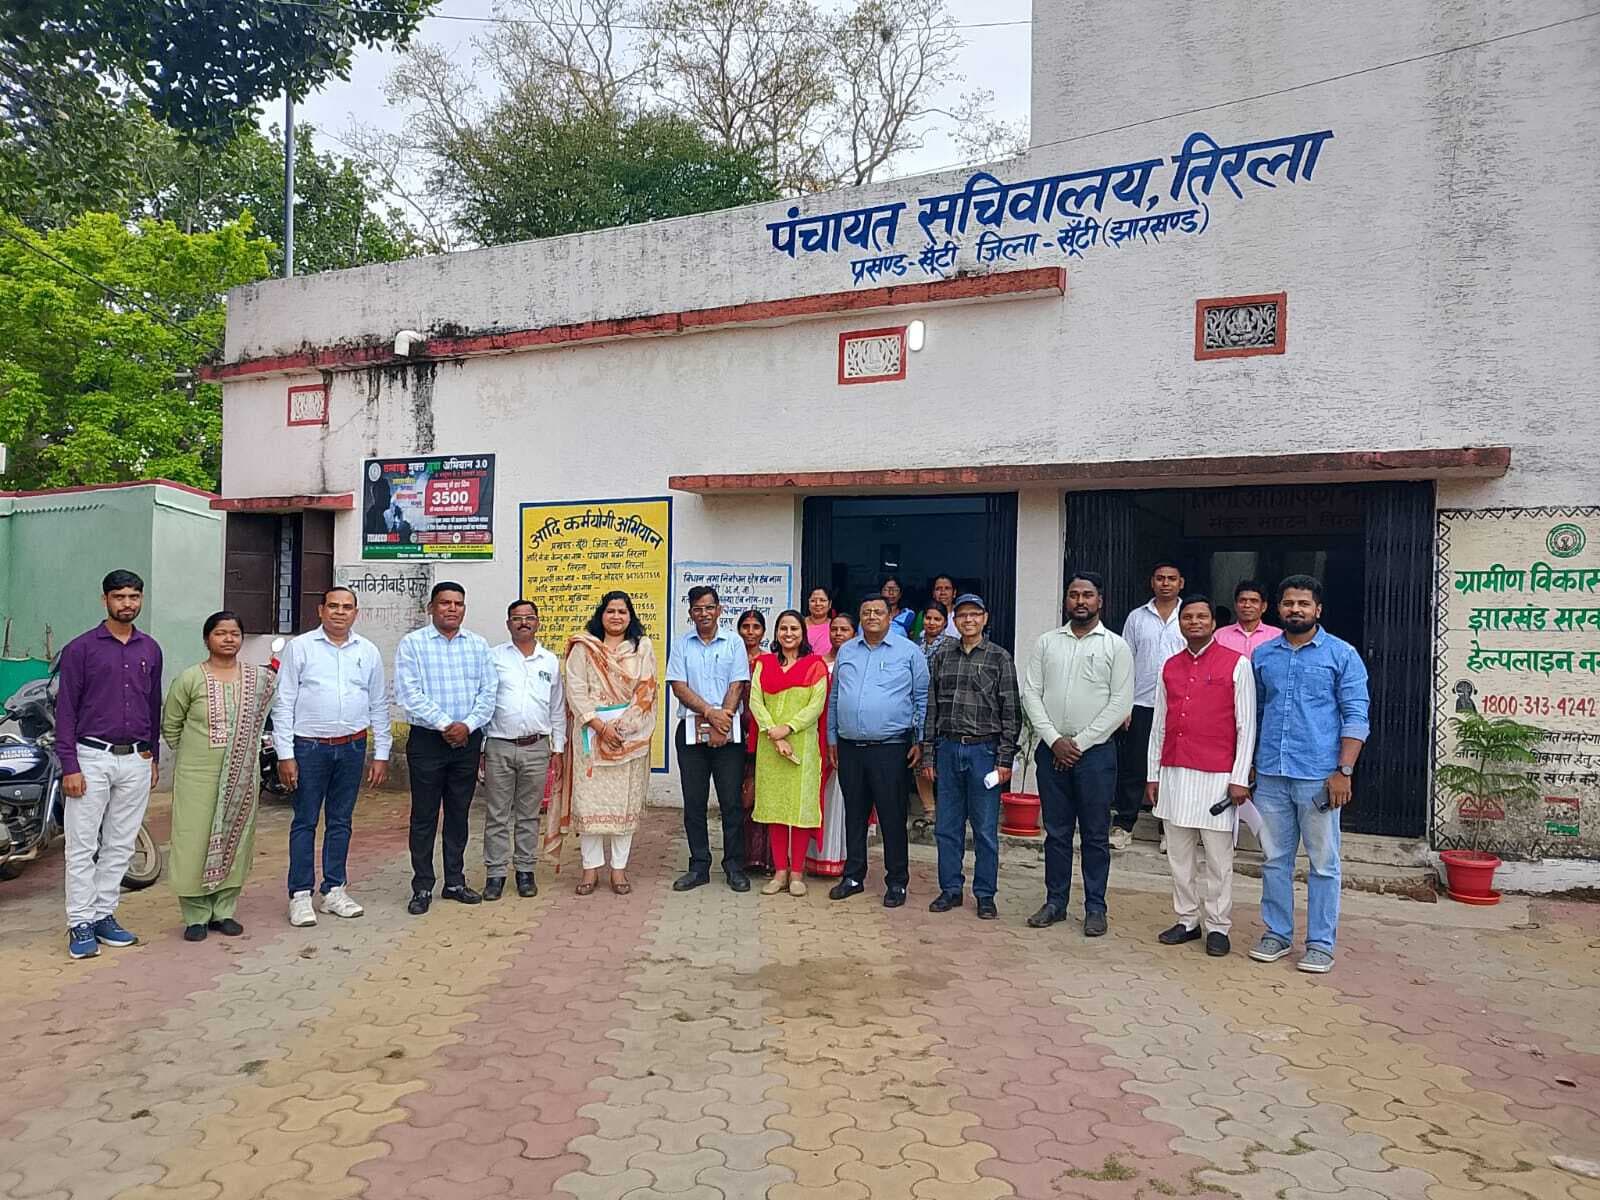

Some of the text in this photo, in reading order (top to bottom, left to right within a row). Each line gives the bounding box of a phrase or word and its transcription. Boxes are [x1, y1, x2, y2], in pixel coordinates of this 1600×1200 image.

[767, 130, 1334, 259] पंचायत सचिवालय, तिरला
[442, 457, 474, 471] अभियान
[431, 491, 469, 505] 3500
[529, 508, 665, 549] आदि कर्मयोगी अभियान
[1454, 563, 1527, 595] ग्रामीण
[1468, 602, 1550, 637] झारखंड
[1466, 639, 1575, 678] हेल्पलाइन
